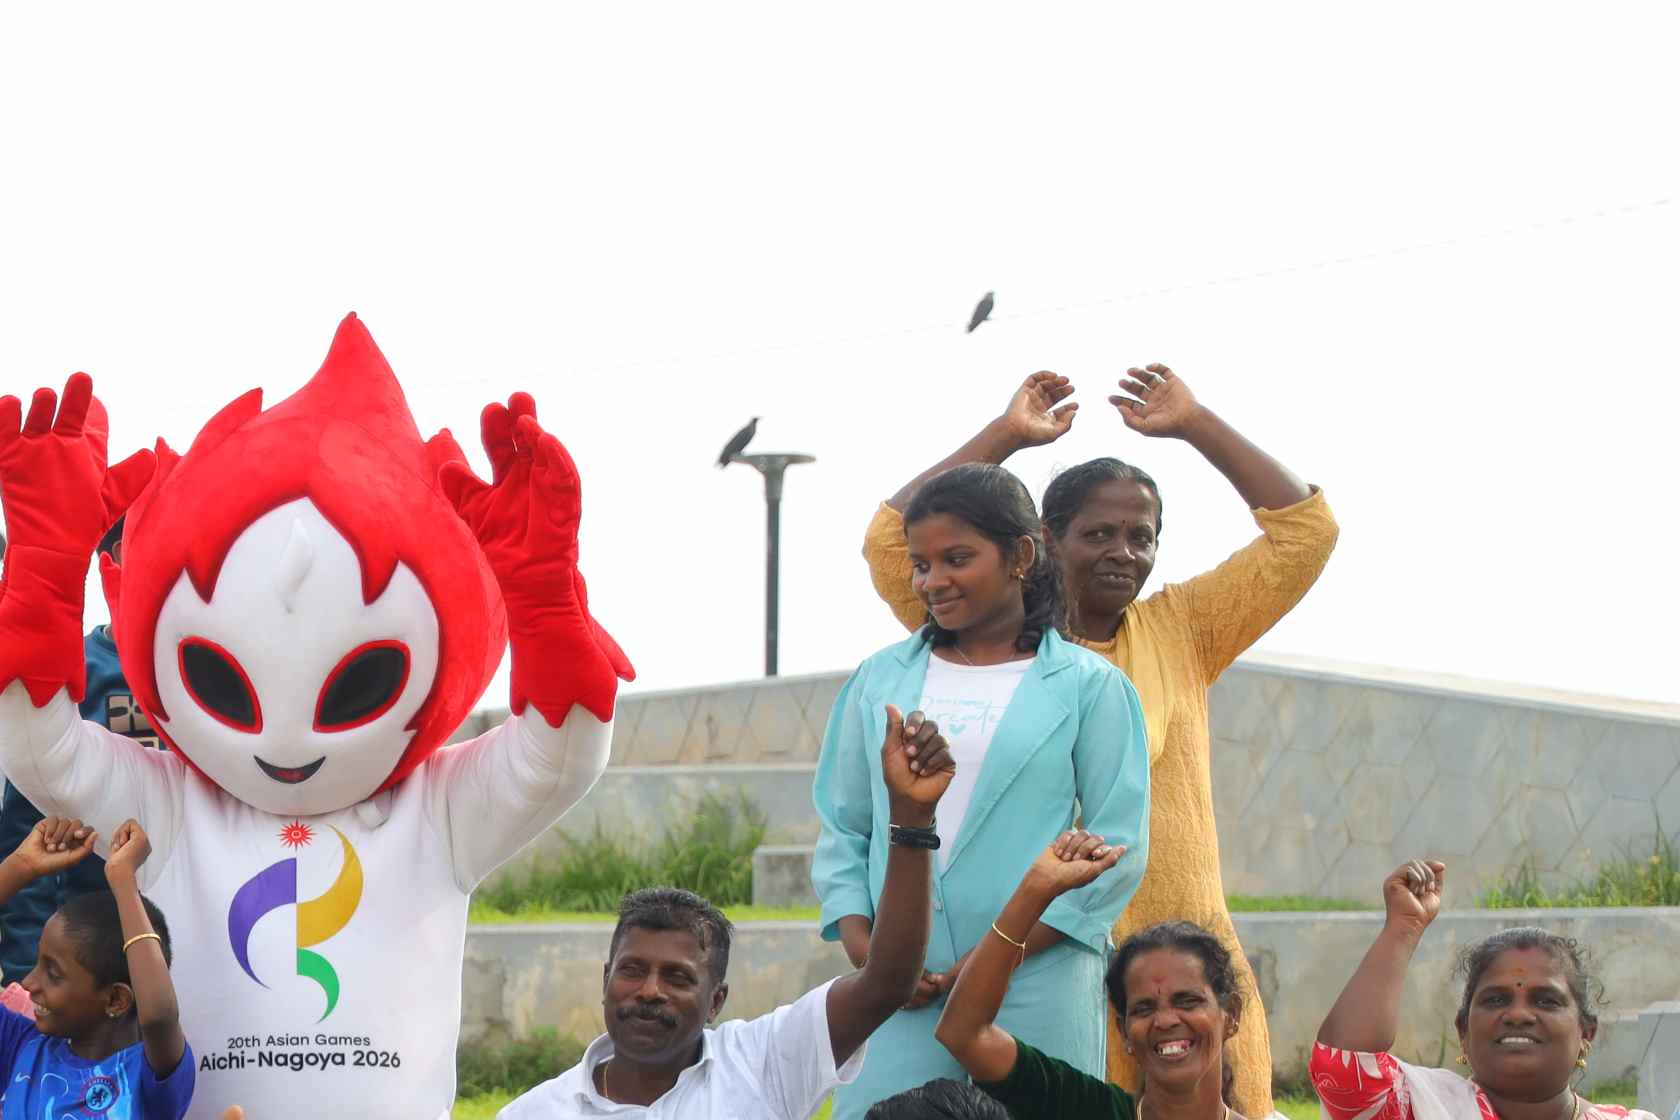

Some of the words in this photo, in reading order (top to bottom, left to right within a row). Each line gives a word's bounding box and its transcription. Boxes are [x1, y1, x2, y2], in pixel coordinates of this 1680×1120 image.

[227, 1035, 261, 1050] 20th
[265, 1033, 310, 1047] Asian
[314, 1033, 371, 1047] Games
[199, 1050, 346, 1072] Aichi-Nagoya
[352, 1050, 401, 1068] 2026
